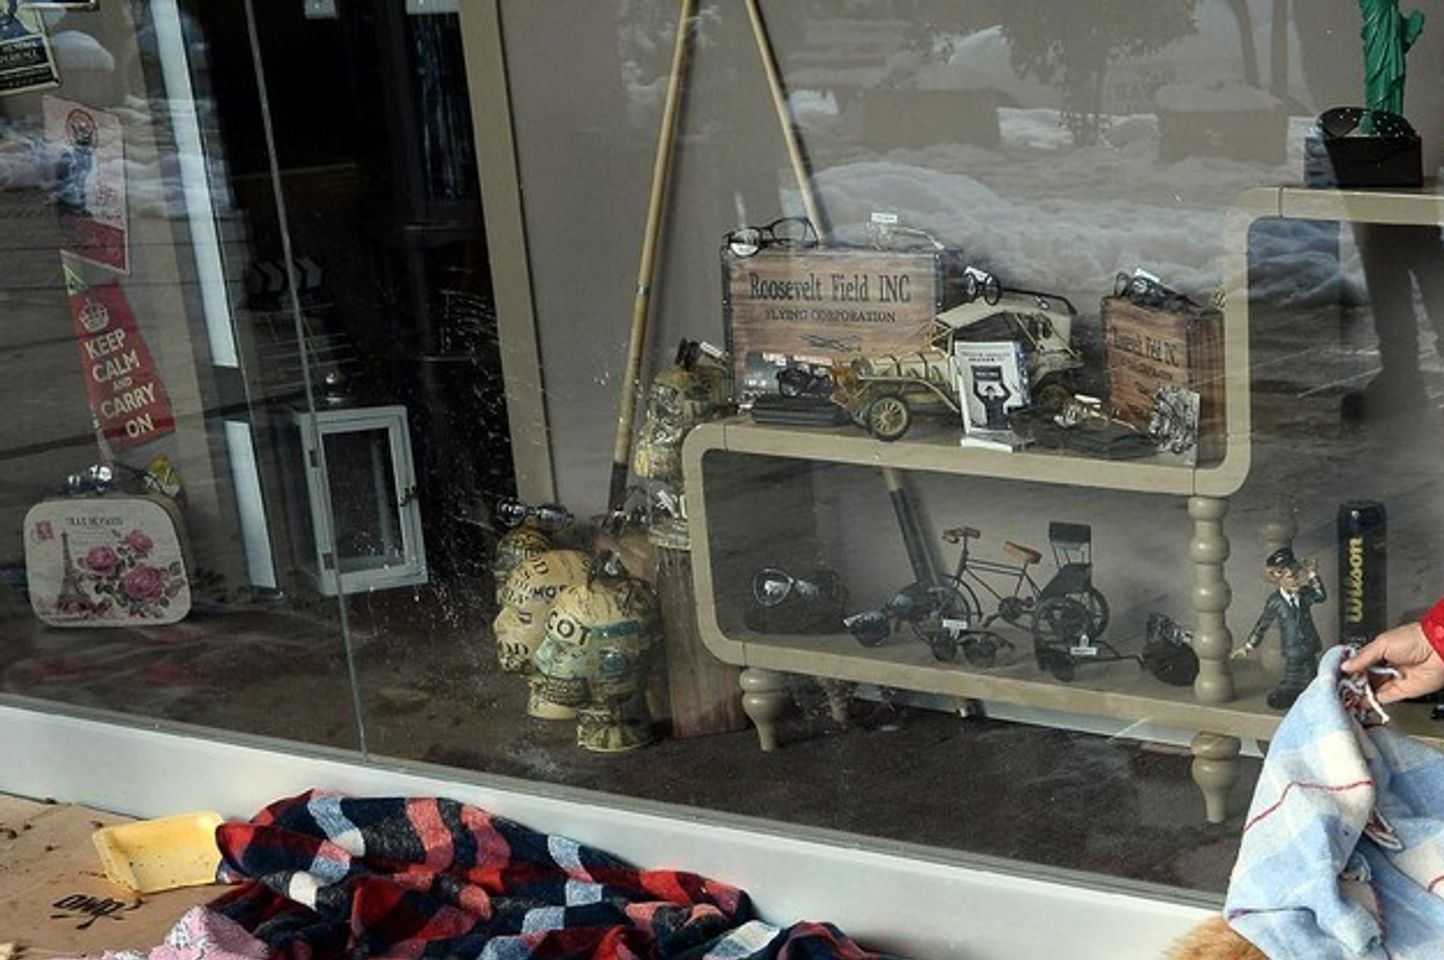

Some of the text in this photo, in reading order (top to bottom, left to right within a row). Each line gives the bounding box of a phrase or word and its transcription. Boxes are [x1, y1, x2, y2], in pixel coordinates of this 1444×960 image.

[749, 272, 912, 303] Roosevelt Field INC
[811, 308, 896, 324] CORPORATION
[84, 328, 126, 360] KEEP
[92, 350, 141, 383] CALM
[112, 376, 133, 392] AND
[101, 383, 157, 419] CARRY
[125, 413, 154, 439] ON
[1346, 536, 1364, 623] Wilson
